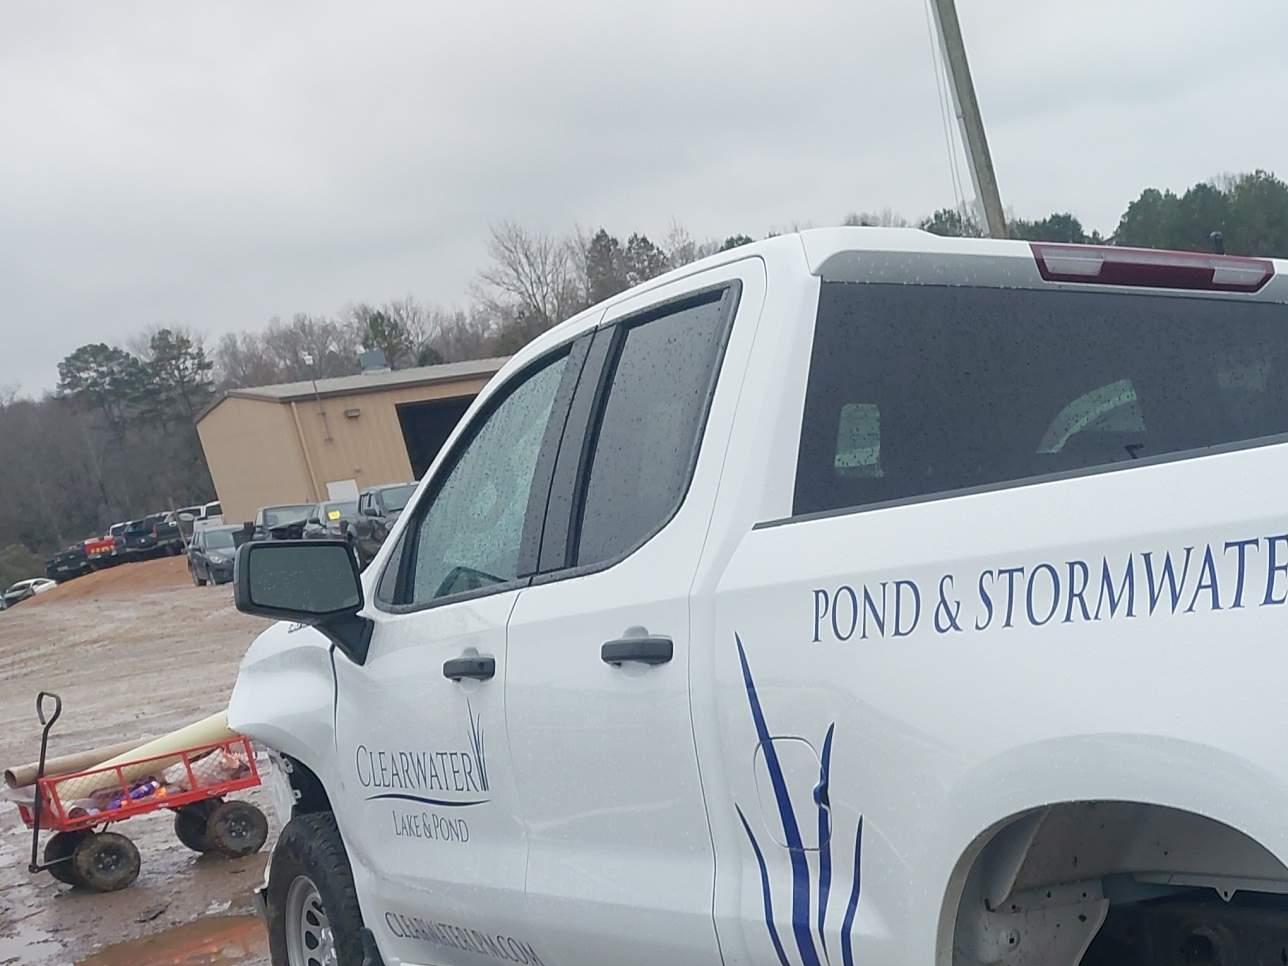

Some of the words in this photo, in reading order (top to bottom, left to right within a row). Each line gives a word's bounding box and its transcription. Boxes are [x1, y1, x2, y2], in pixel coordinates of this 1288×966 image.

[811, 574, 921, 643] POND
[934, 574, 963, 634] &
[356, 745, 479, 792] CLEARWATER
[392, 810, 421, 837] LAKE
[422, 812, 433, 839] &
[432, 814, 470, 843] POND
